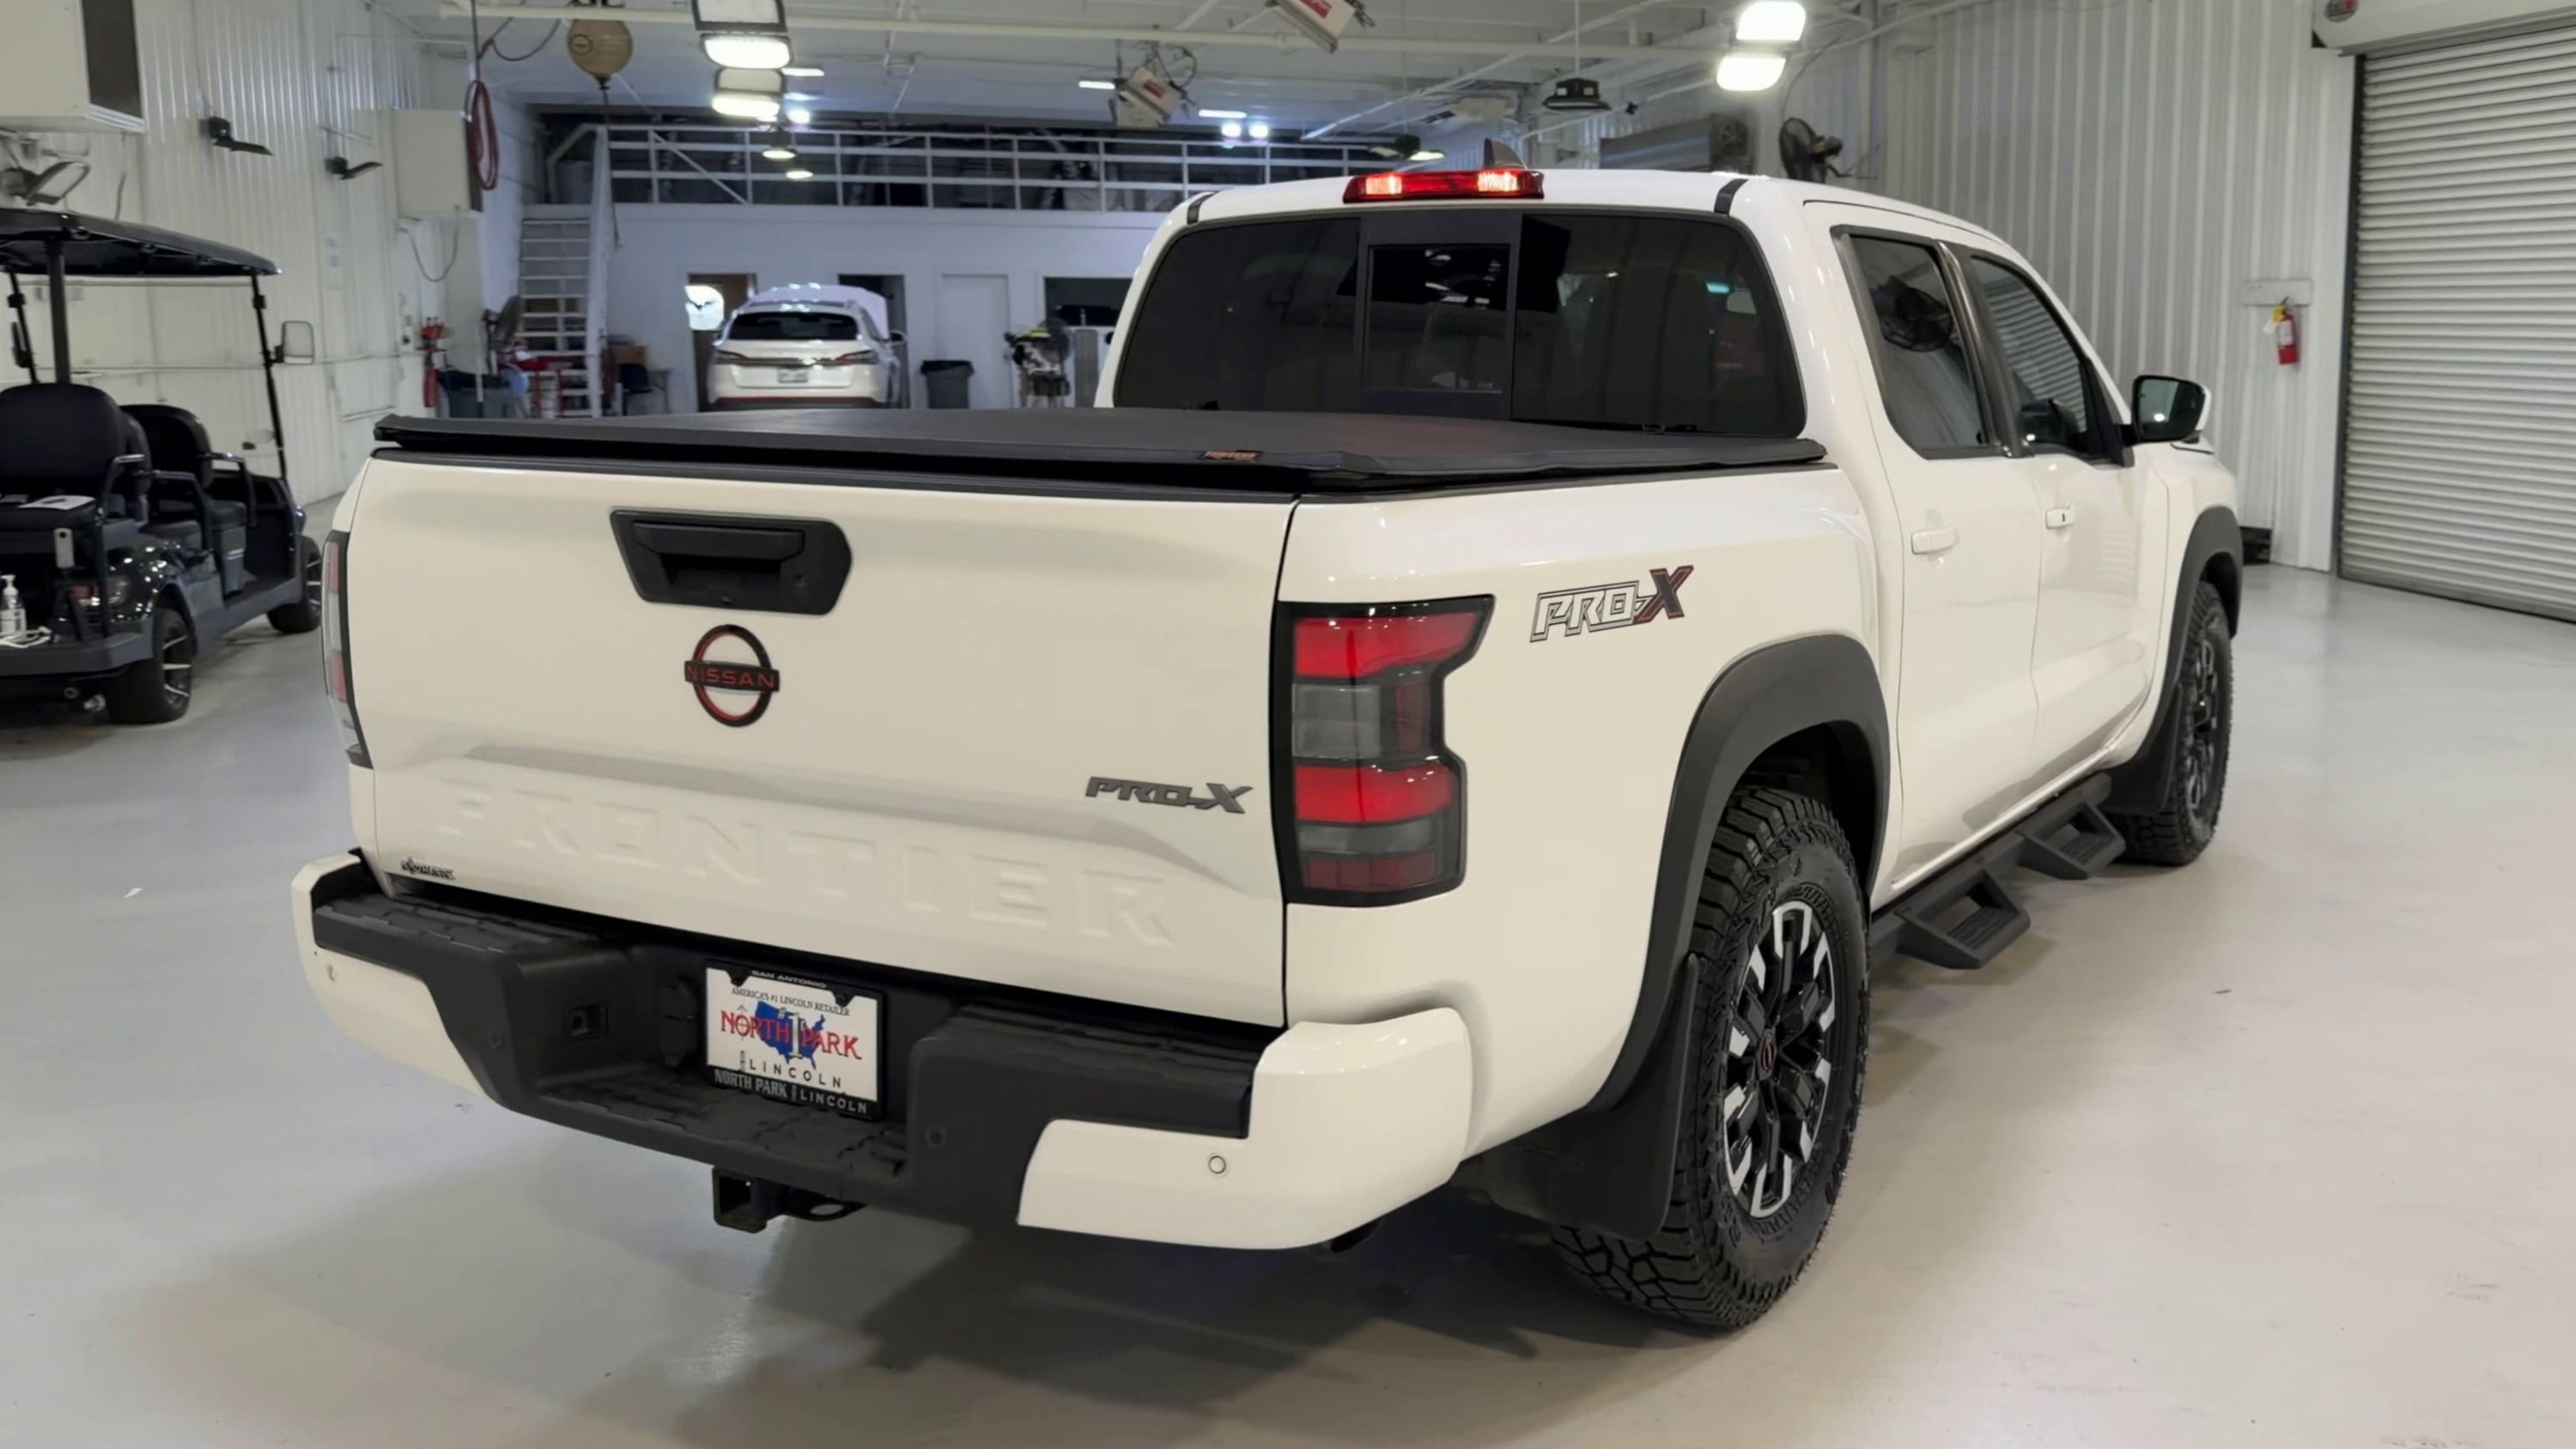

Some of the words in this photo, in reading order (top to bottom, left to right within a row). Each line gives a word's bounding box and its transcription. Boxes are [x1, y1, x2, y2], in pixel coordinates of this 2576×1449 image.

[1529, 565, 1694, 643] PRO-X
[687, 665, 775, 688] NISSAN
[1084, 776, 1253, 814] PRO-X
[435, 775, 1178, 948] FRONTIER
[751, 970, 775, 979] SAN
[777, 974, 827, 988] ANTONIO
[732, 987, 769, 1002] AMERICA'S
[780, 996, 813, 1009] LINCOLN
[815, 1002, 850, 1016] RETAILER
[720, 1009, 791, 1045] NORTH
[801, 1022, 862, 1060] PARK
[714, 1069, 752, 1090] NORTH
[756, 1077, 788, 1099] PARK
[800, 1088, 867, 1114] LINCOLN
[750, 1058, 841, 1088] LINCOLN
